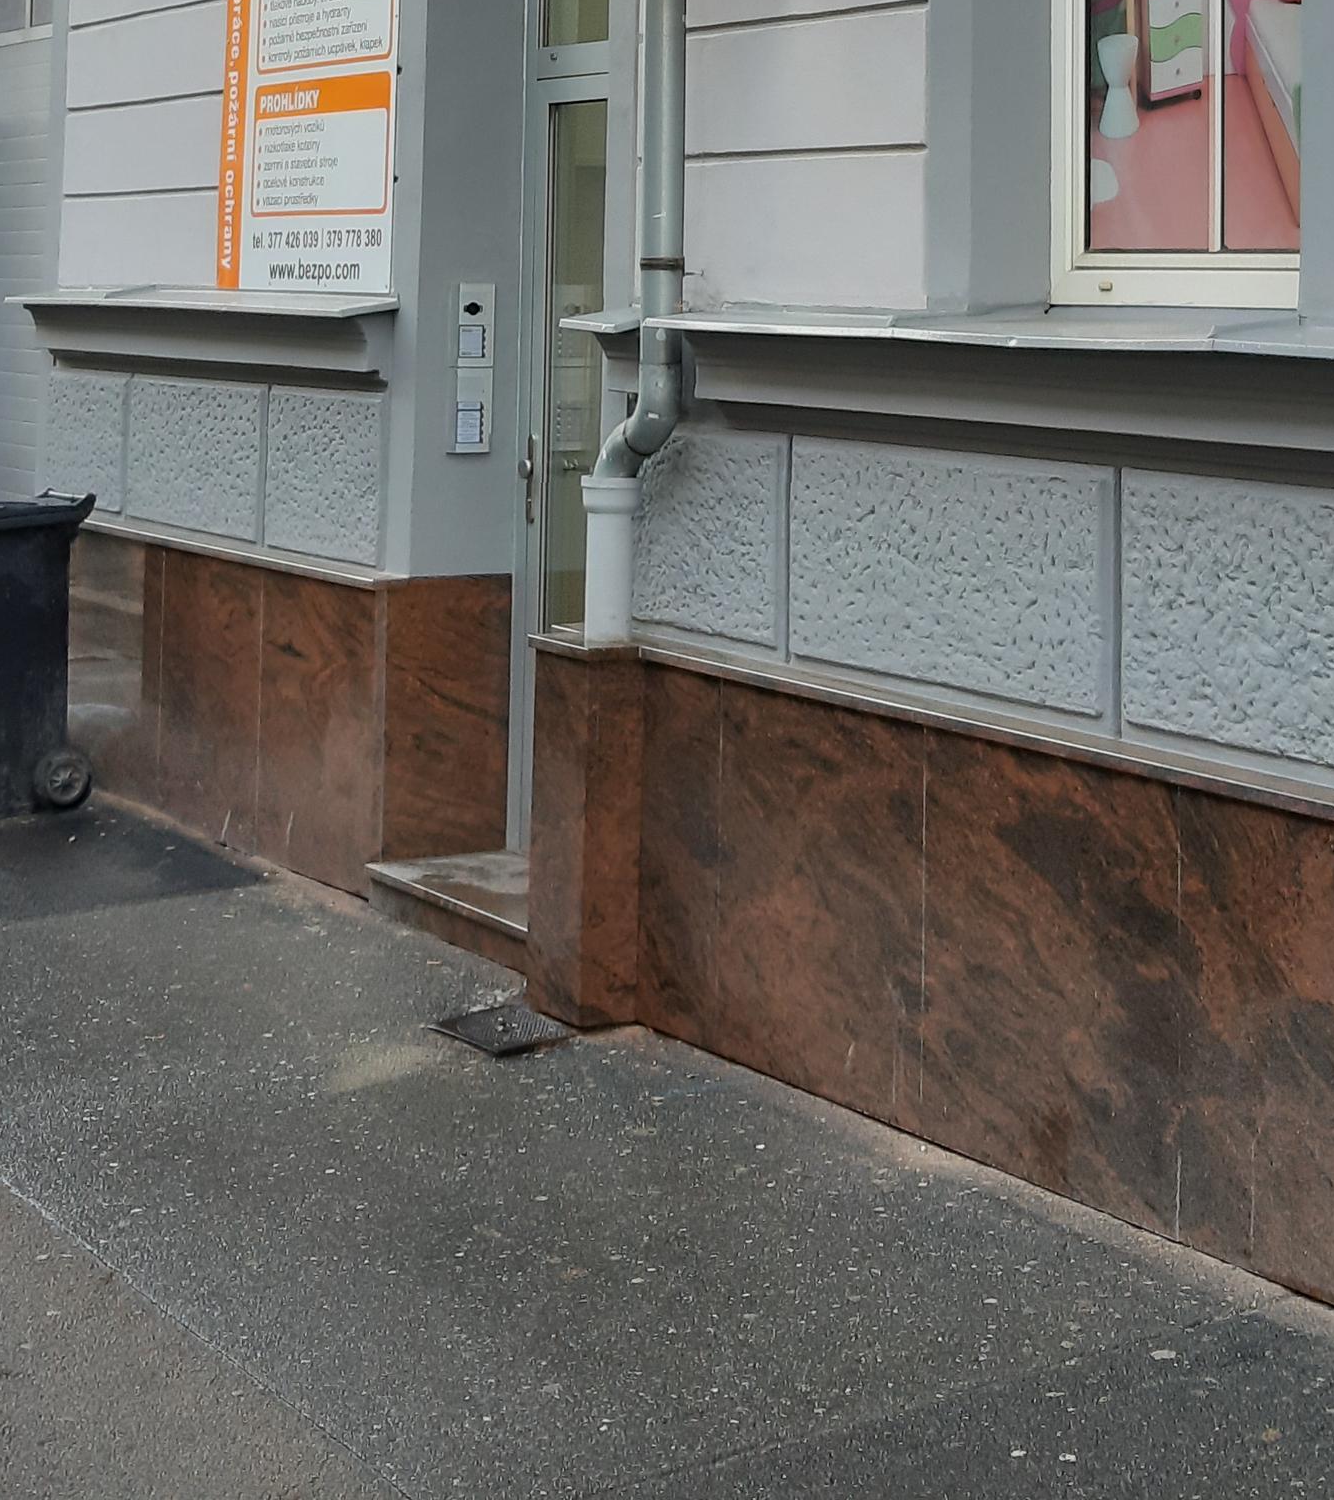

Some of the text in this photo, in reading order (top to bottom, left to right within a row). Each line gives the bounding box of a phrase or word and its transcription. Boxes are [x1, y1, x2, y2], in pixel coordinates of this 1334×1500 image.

[260, 86, 320, 114] PROHLÍDKY
[226, 71, 241, 161] požární
[221, 170, 236, 269] ochrany
[253, 228, 382, 249] tel. 377 426 039 379 778 380
[269, 257, 360, 285] www.bezpo.com
